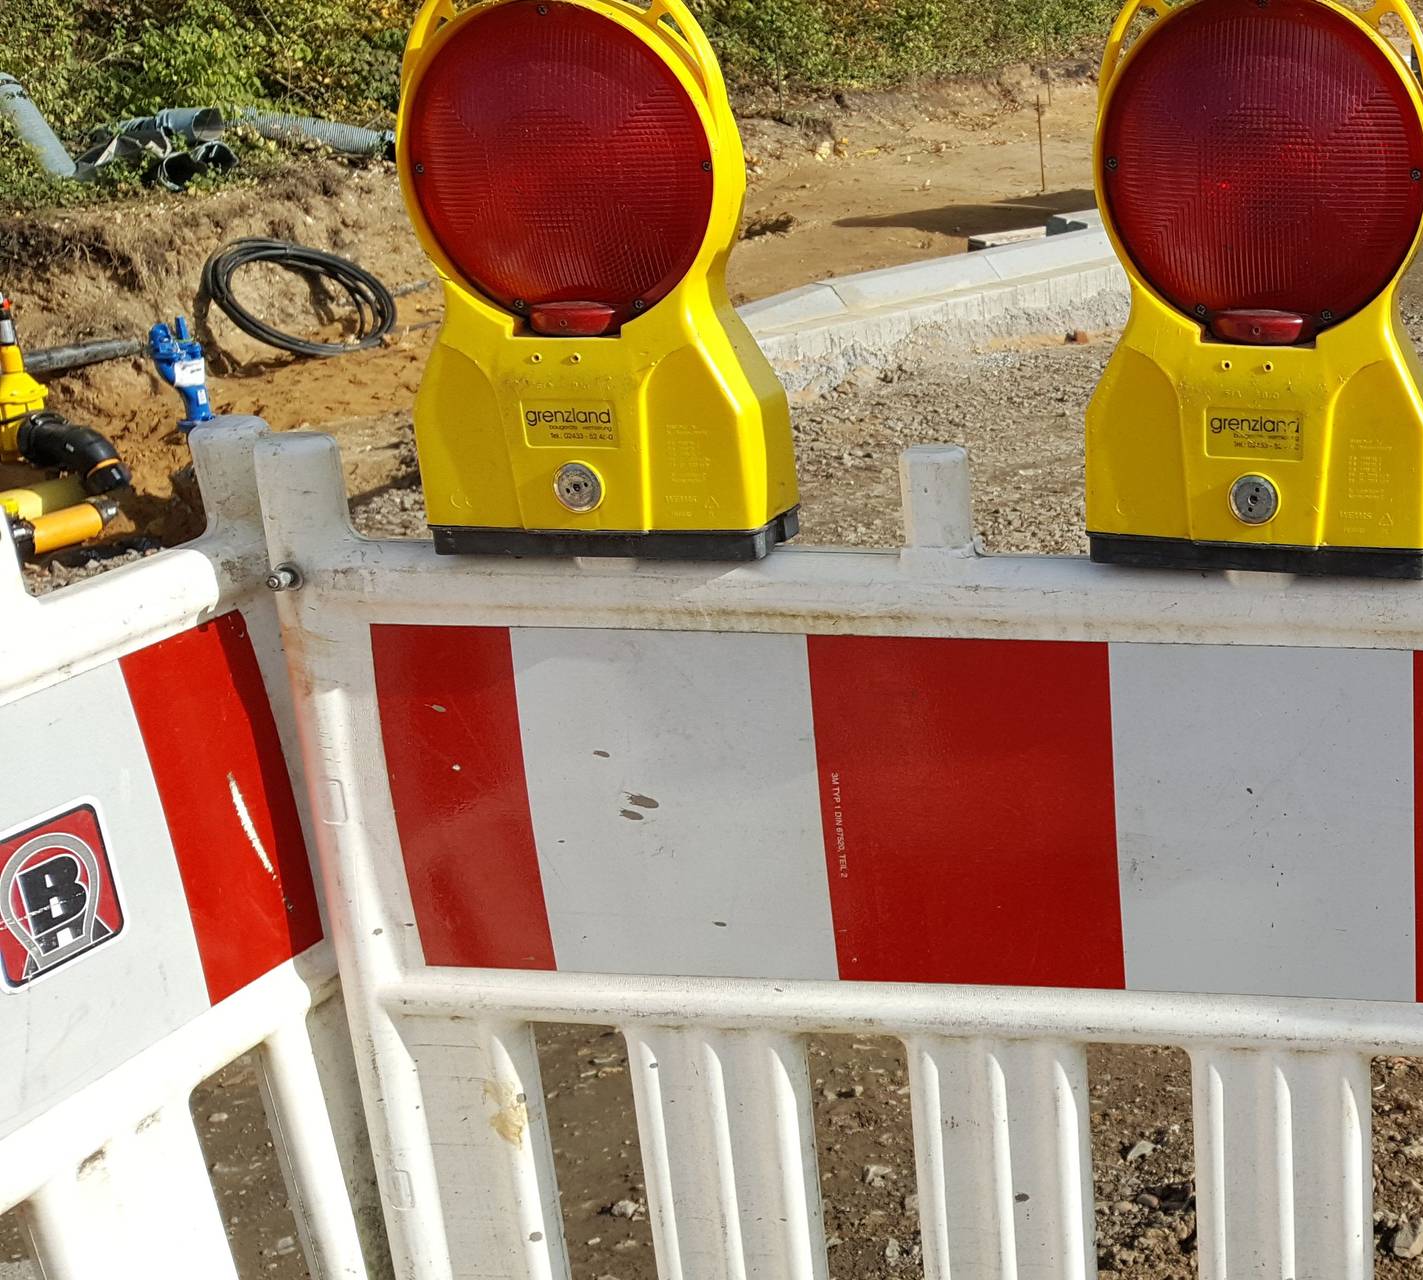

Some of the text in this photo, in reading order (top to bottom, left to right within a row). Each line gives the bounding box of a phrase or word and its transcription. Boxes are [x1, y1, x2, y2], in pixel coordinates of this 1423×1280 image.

[525, 408, 611, 427] grenzland
[1210, 416, 1300, 434] grenzland
[831, 771, 840, 785] 3M
[832, 787, 842, 803] TYP
[834, 811, 843, 826] DIN
[839, 854, 848, 871] TEIL
